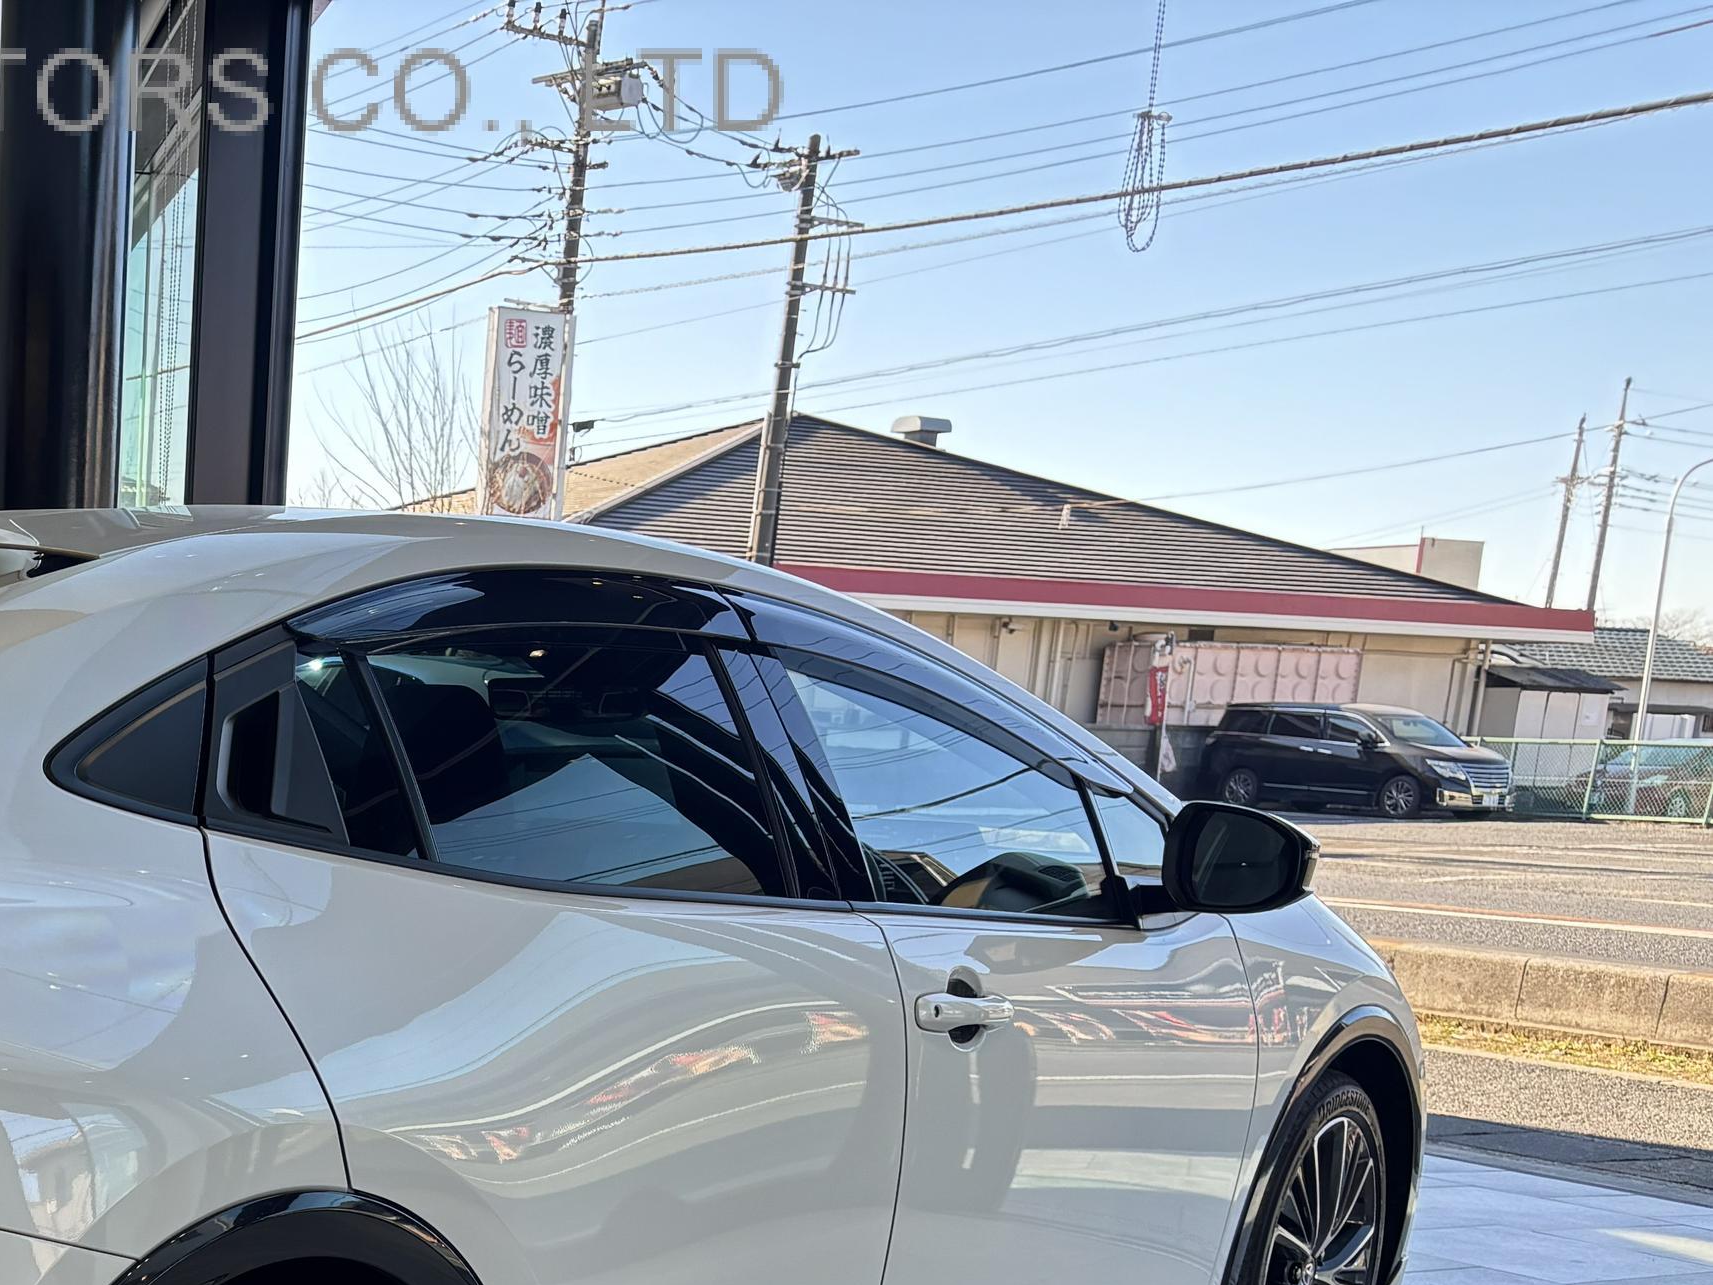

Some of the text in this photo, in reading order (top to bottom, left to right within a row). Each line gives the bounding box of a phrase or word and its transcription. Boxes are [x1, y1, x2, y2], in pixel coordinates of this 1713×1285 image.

[500, 350, 526, 452] らーめん
[527, 325, 556, 435] 濃厚味噌
